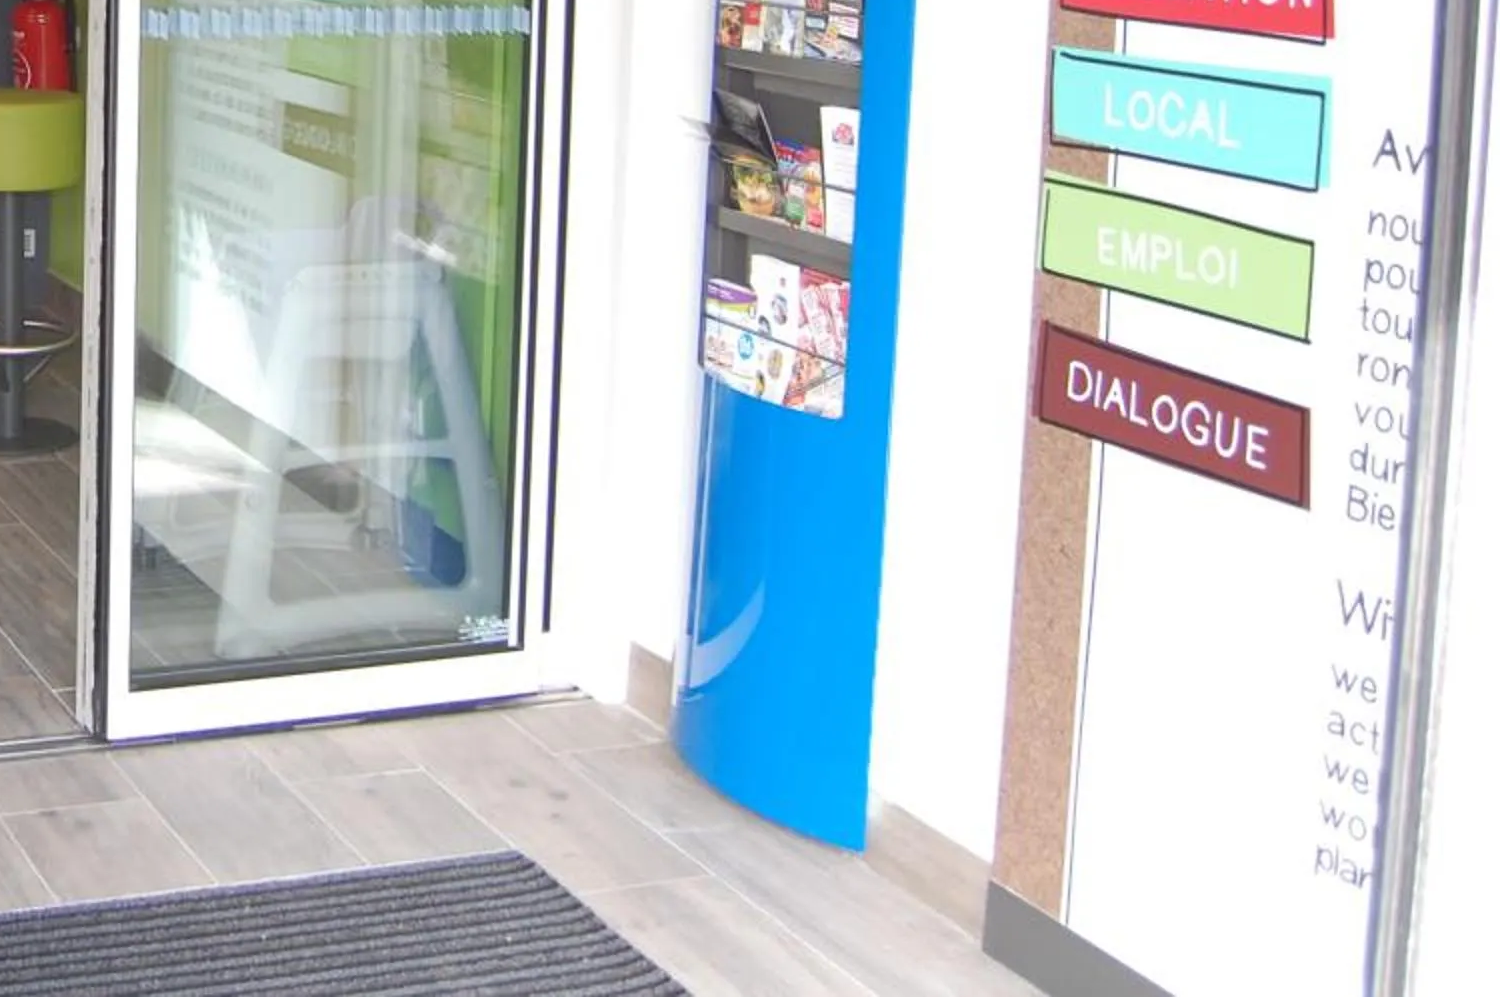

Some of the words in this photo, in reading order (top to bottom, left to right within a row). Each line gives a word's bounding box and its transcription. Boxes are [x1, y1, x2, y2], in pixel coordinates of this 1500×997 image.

[1102, 83, 1239, 148] LOCAL
[1096, 226, 1239, 289] EMPLOI
[1066, 359, 1271, 471] DIALOGUE
[1346, 484, 1396, 531] Bie
[1330, 663, 1378, 704] we
[1326, 709, 1380, 756] act
[1323, 752, 1370, 795] we
[1318, 798, 1368, 842] wo
